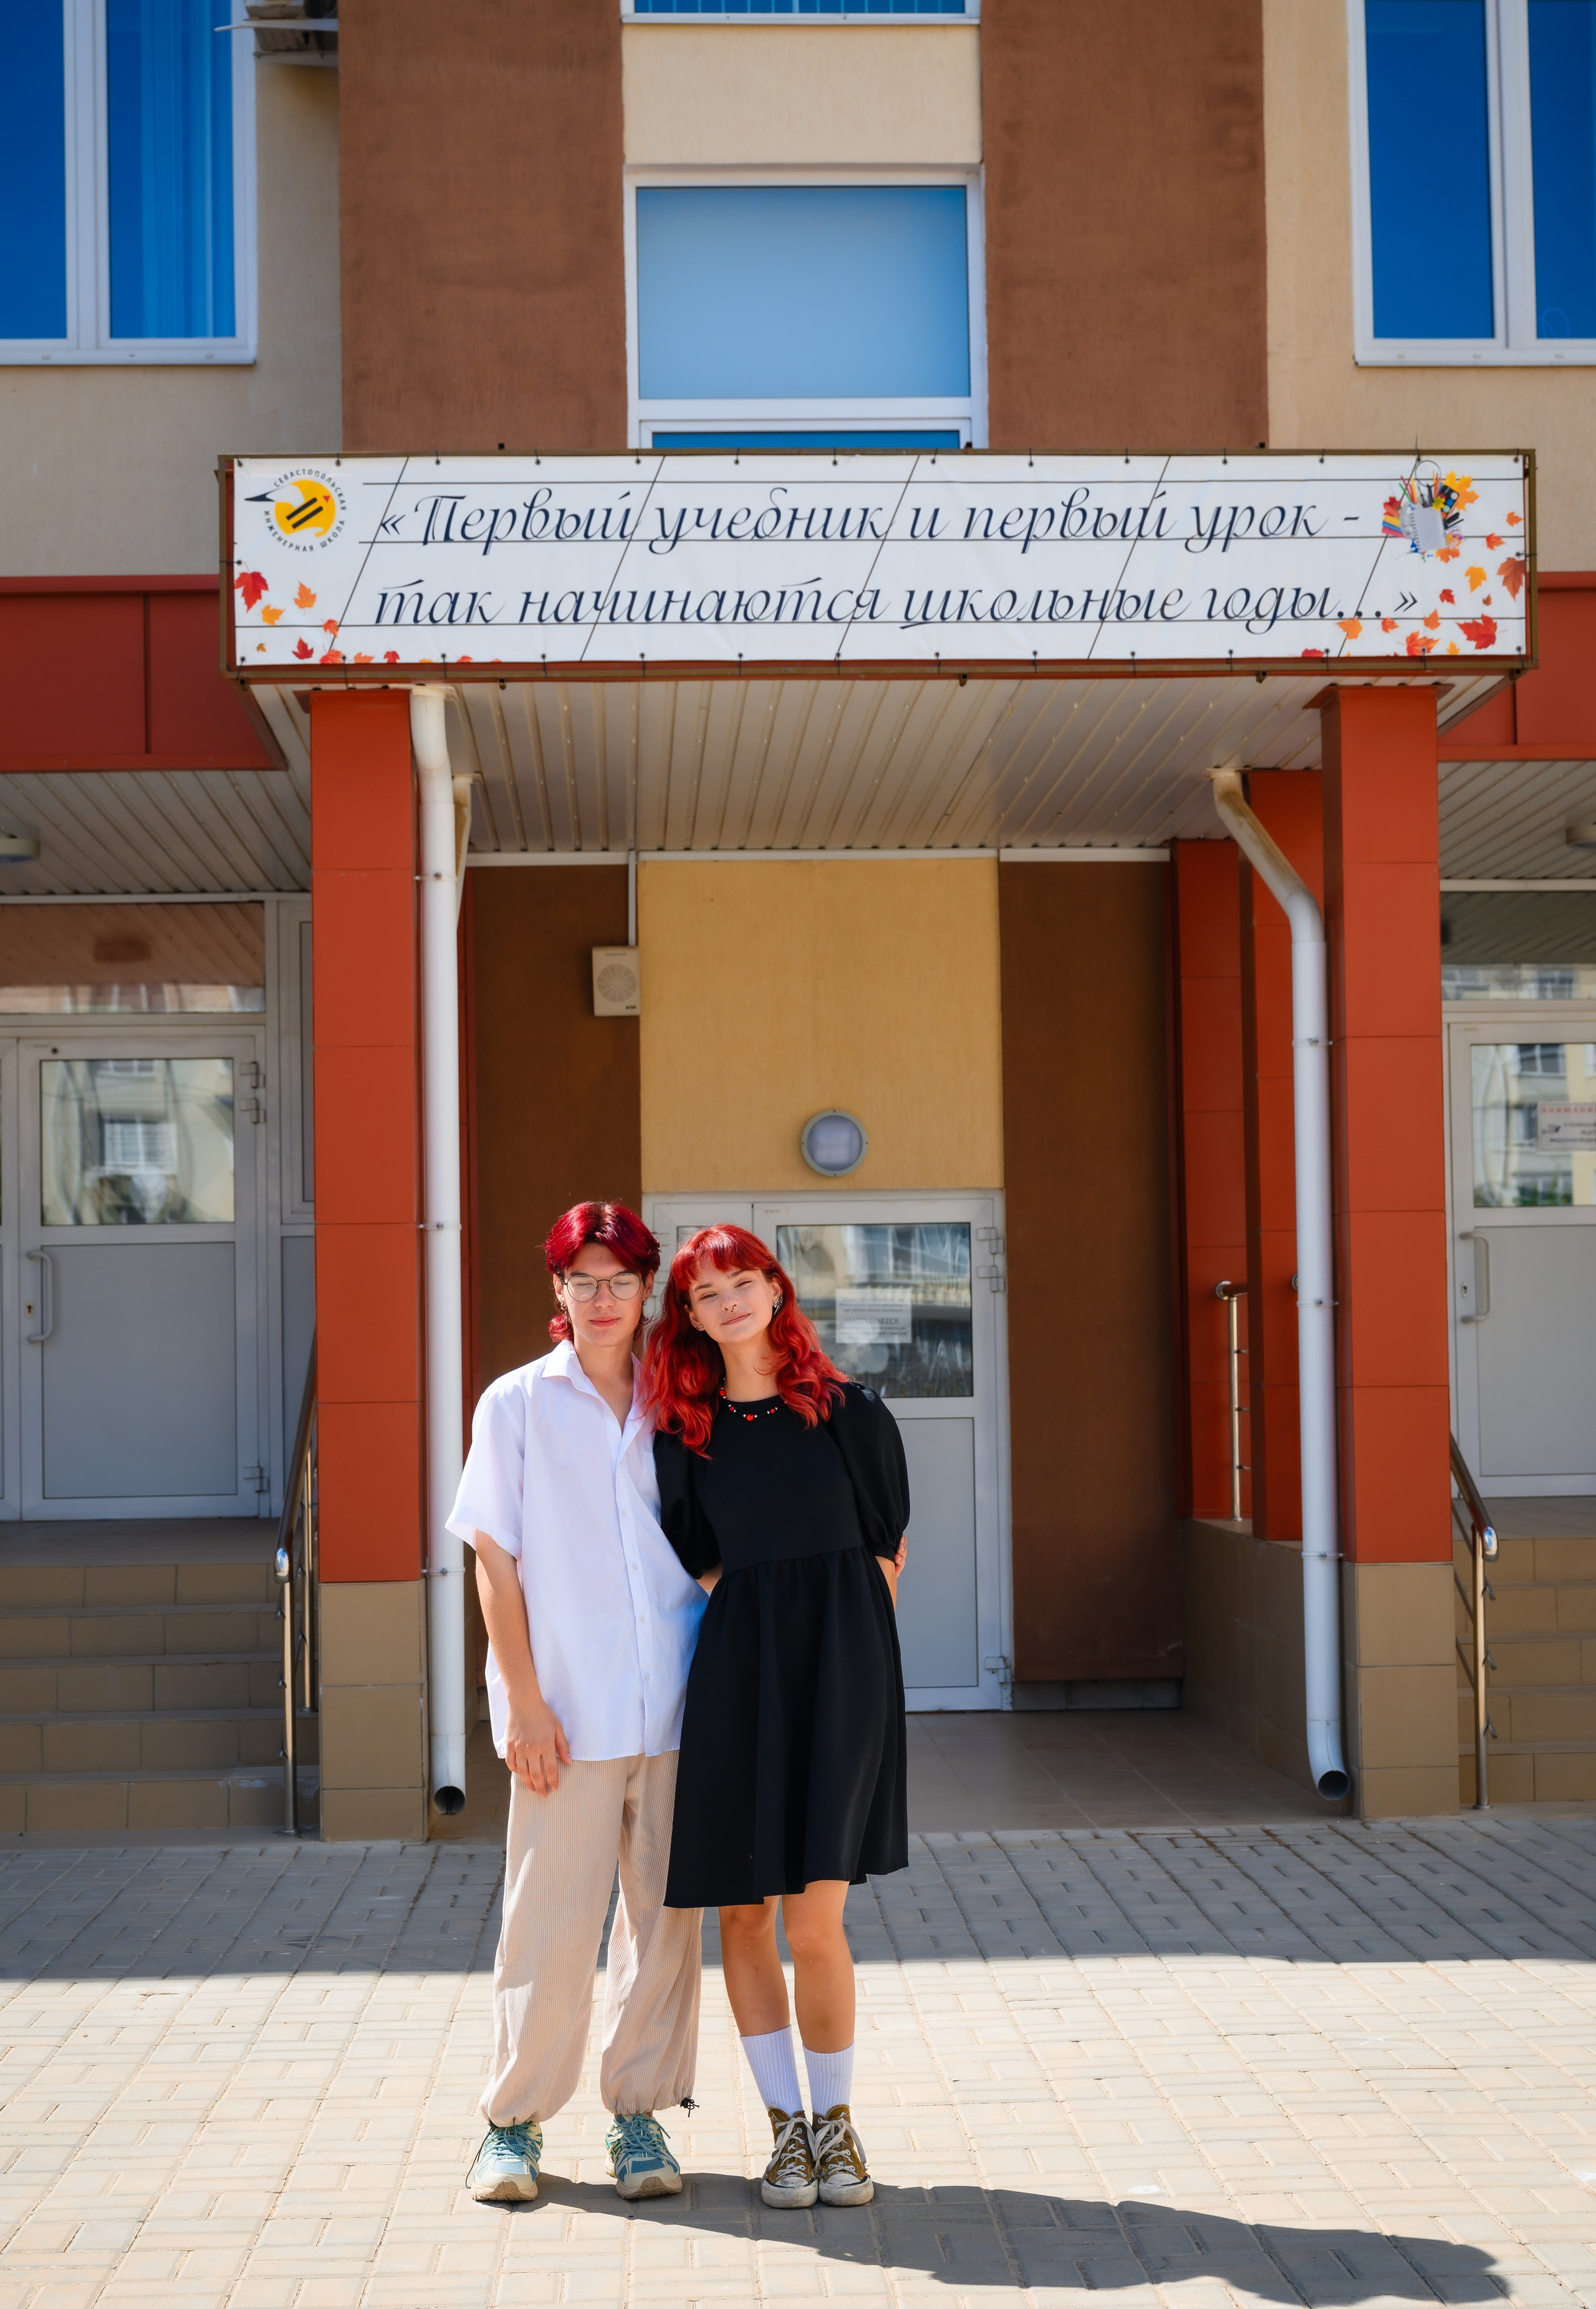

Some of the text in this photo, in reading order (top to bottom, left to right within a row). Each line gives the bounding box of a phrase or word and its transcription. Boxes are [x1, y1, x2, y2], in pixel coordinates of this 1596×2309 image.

[274, 469, 347, 511] СЕВАСТОПОЛЬСКАЯ
[264, 510, 345, 552] ИНЖЕНЕРНАЯ ШКОЛА
[380, 487, 641, 556] «Первый
[648, 487, 895, 554] учебник
[911, 508, 951, 540] и
[964, 487, 1178, 554] первый
[1185, 505, 1330, 553] урок
[375, 579, 506, 624] так
[519, 576, 892, 623] начинаются
[899, 588, 1193, 630] школьные
